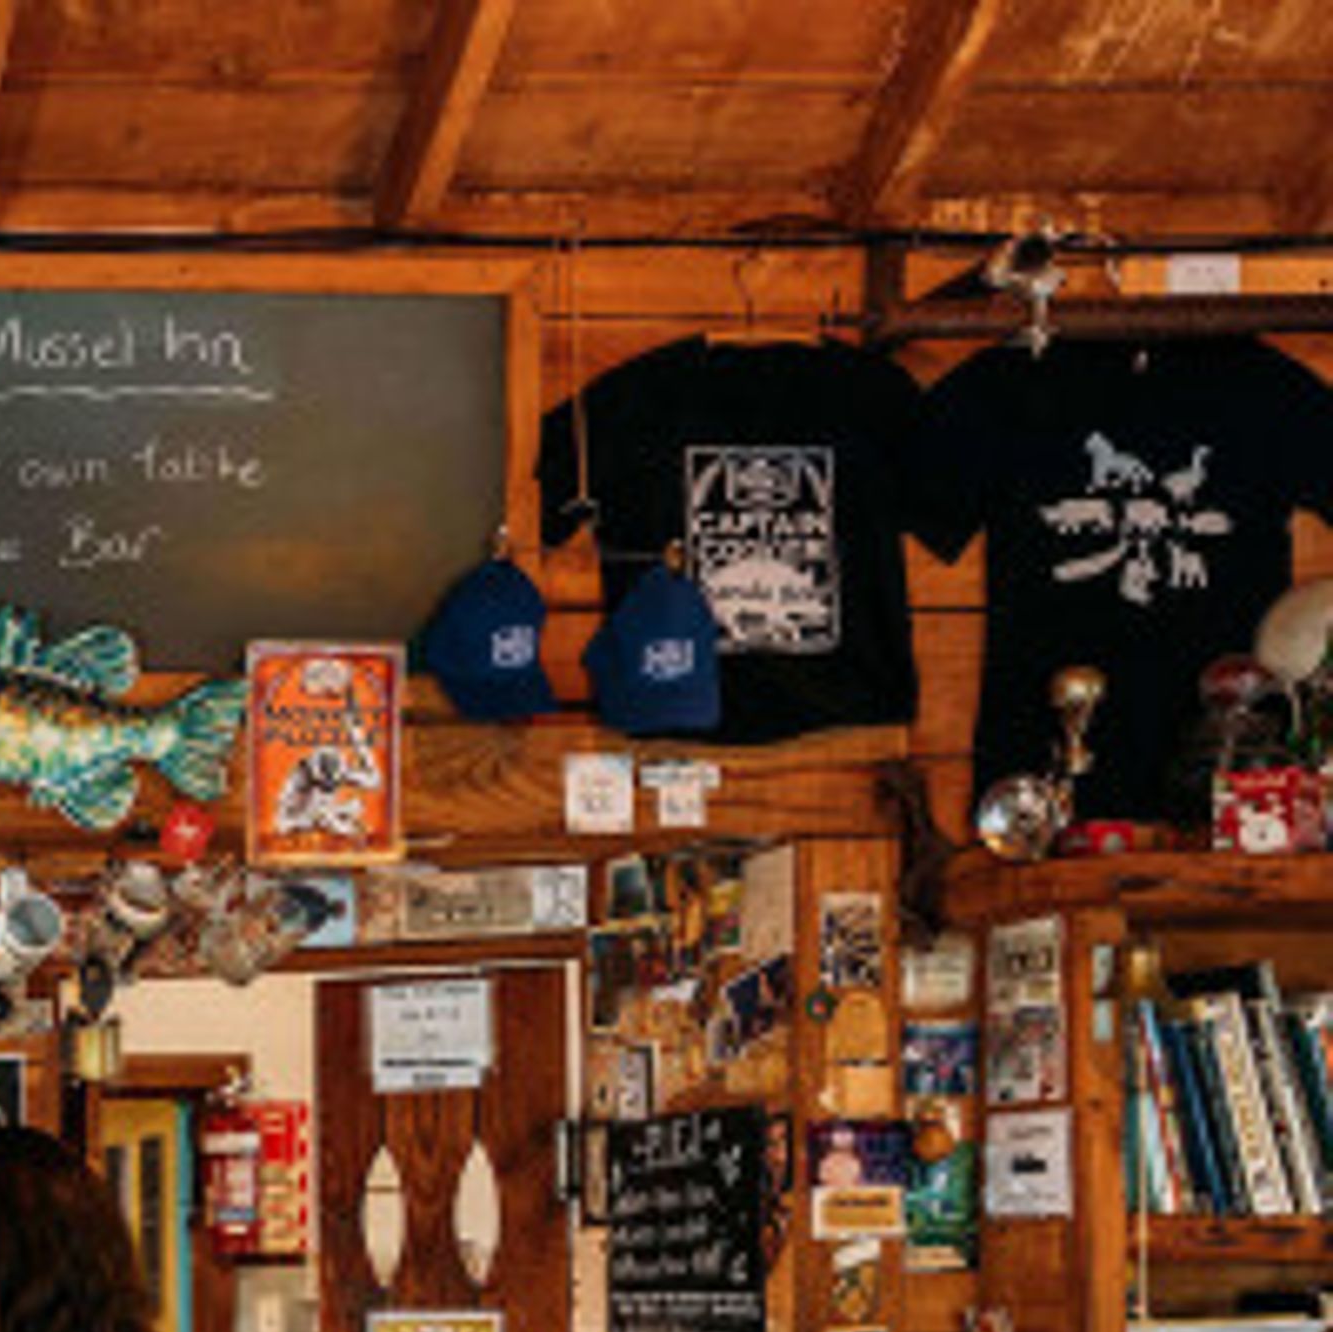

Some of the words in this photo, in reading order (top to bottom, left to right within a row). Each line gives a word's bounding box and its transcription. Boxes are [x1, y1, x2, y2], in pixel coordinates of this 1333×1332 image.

[164, 314, 253, 374] Inn
[18, 457, 109, 488] own
[58, 514, 163, 568] Bar
